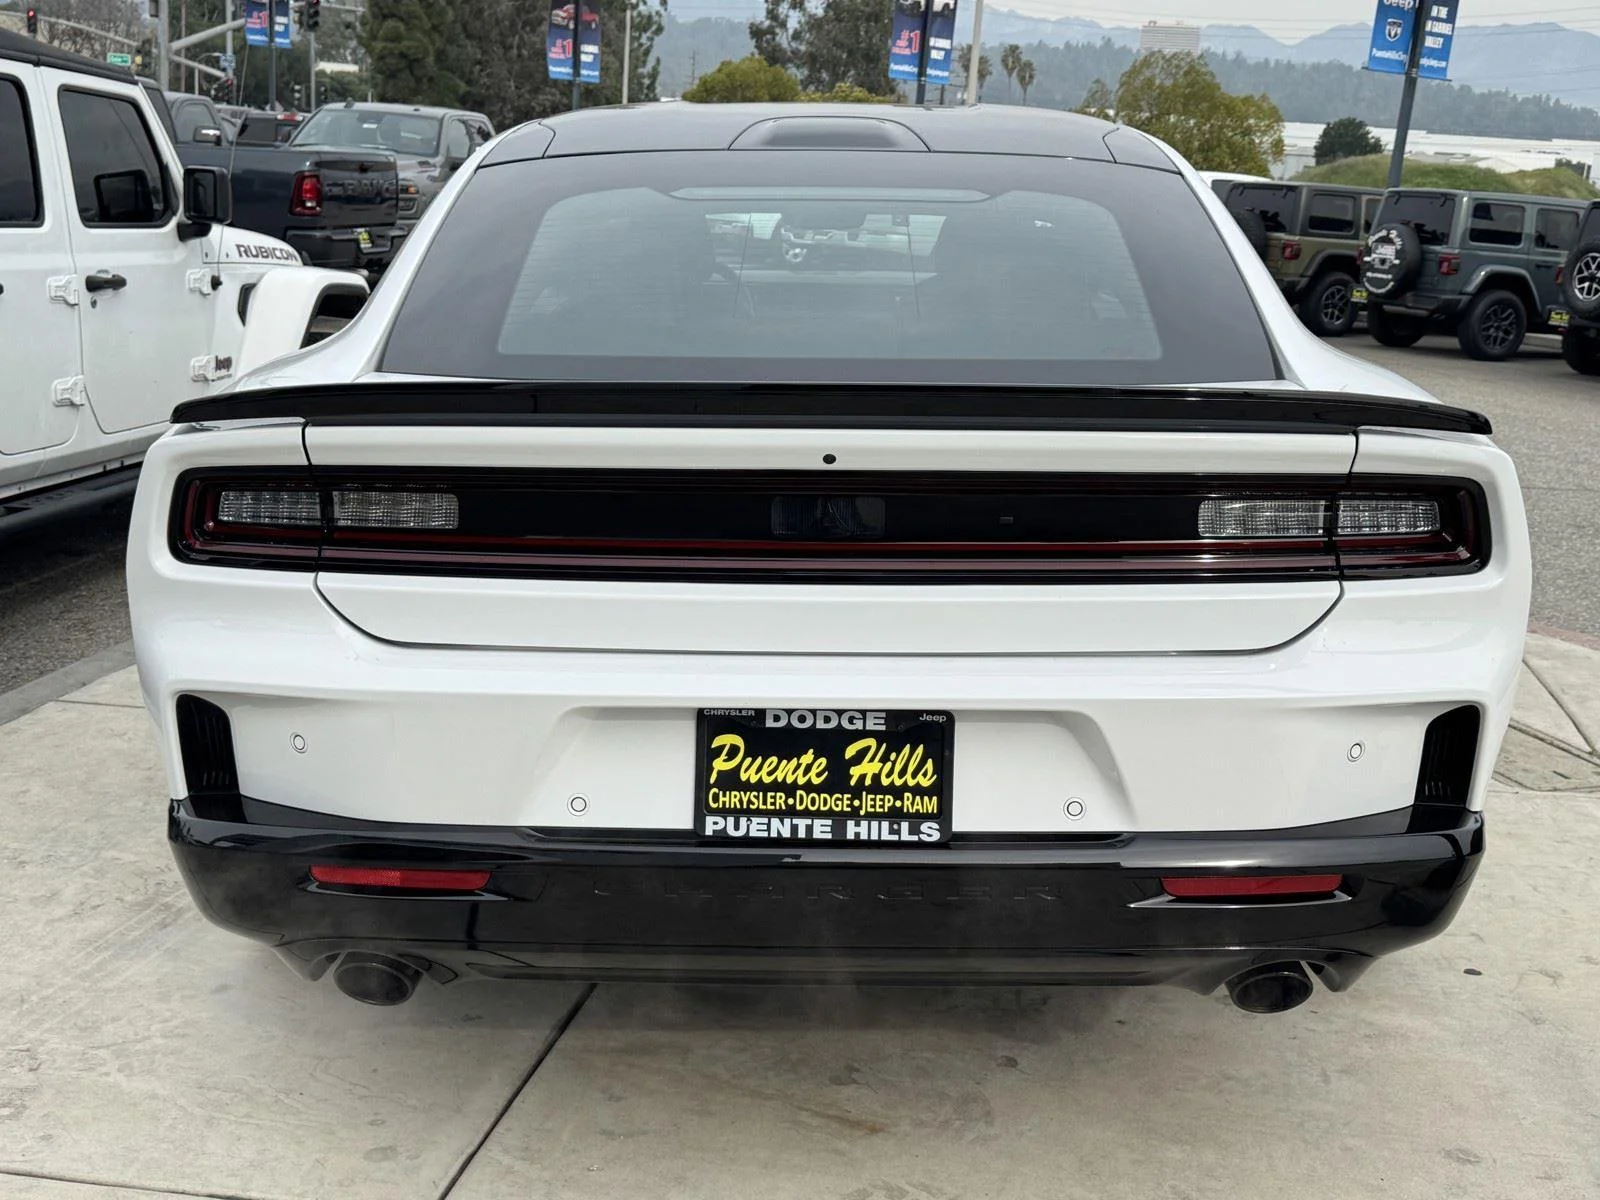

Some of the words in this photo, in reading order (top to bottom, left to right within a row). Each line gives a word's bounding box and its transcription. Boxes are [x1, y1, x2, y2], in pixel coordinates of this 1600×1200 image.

[235, 244, 299, 262] RUBICON
[215, 355, 232, 373] Jeep
[704, 708, 755, 716] CHRYSLER
[765, 709, 887, 731] DODGE
[919, 713, 947, 722] Jeep
[709, 733, 828, 785] Puente
[844, 737, 938, 787] Hills
[704, 816, 833, 839] PUENTE
[846, 820, 941, 842] HILLS
